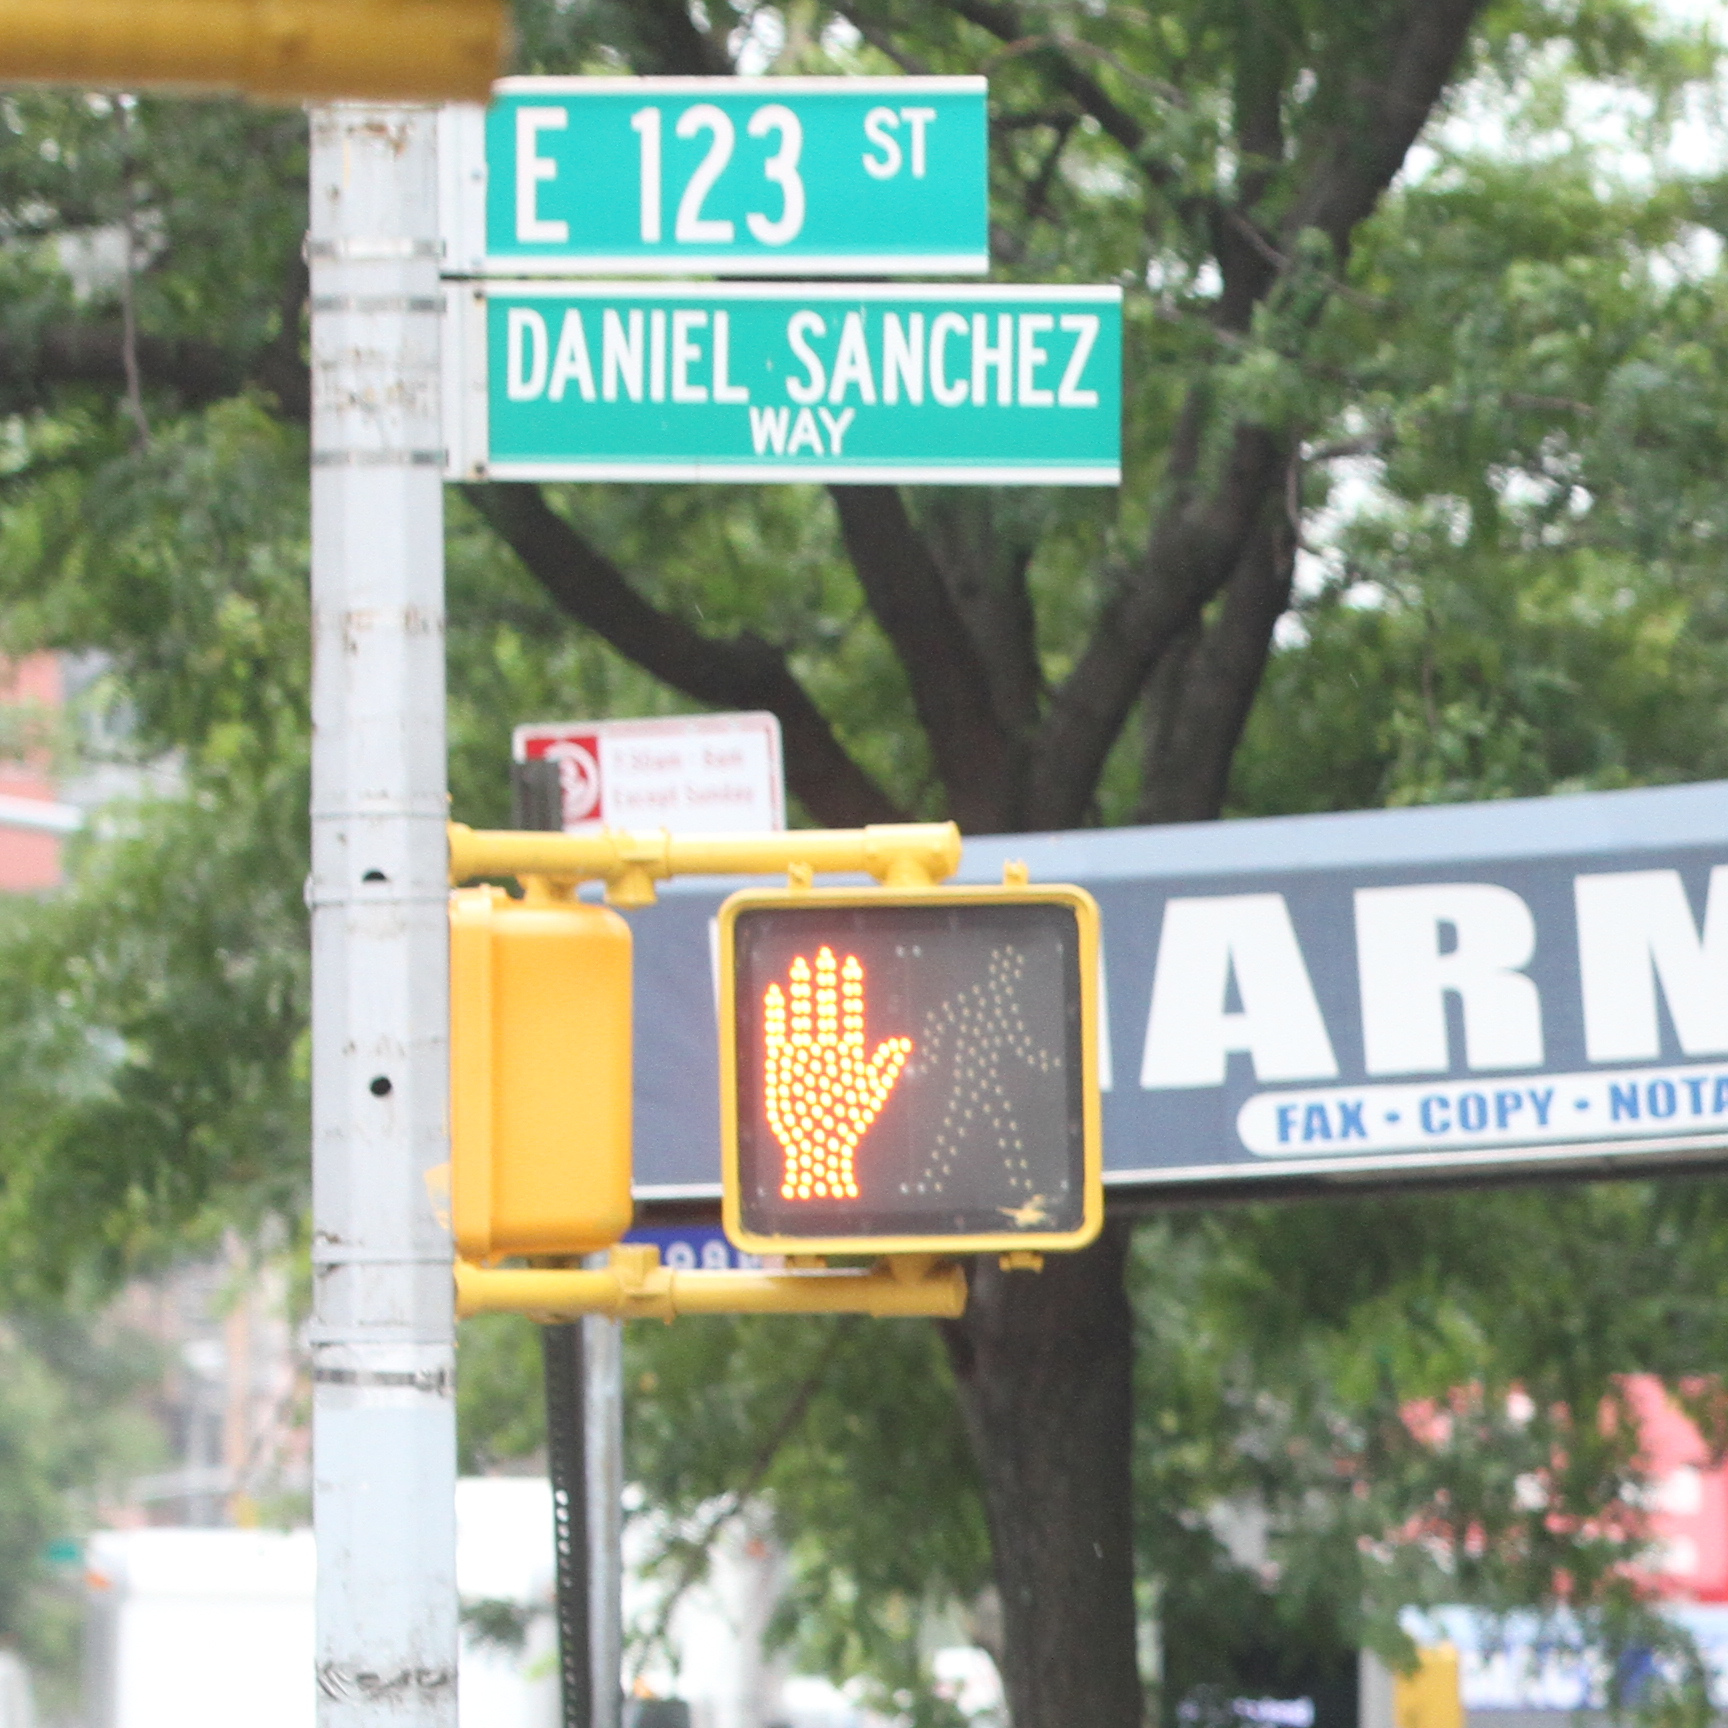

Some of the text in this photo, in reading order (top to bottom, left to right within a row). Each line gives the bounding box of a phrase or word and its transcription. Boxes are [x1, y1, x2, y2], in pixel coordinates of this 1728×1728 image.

[514, 104, 936, 247] E 123 ST
[504, 307, 1100, 409] DANIEL SANCHEZ
[749, 407, 854, 455] WAY
[1275, 1093, 1368, 1145] FAX
[1418, 1082, 1555, 1136] COPY
